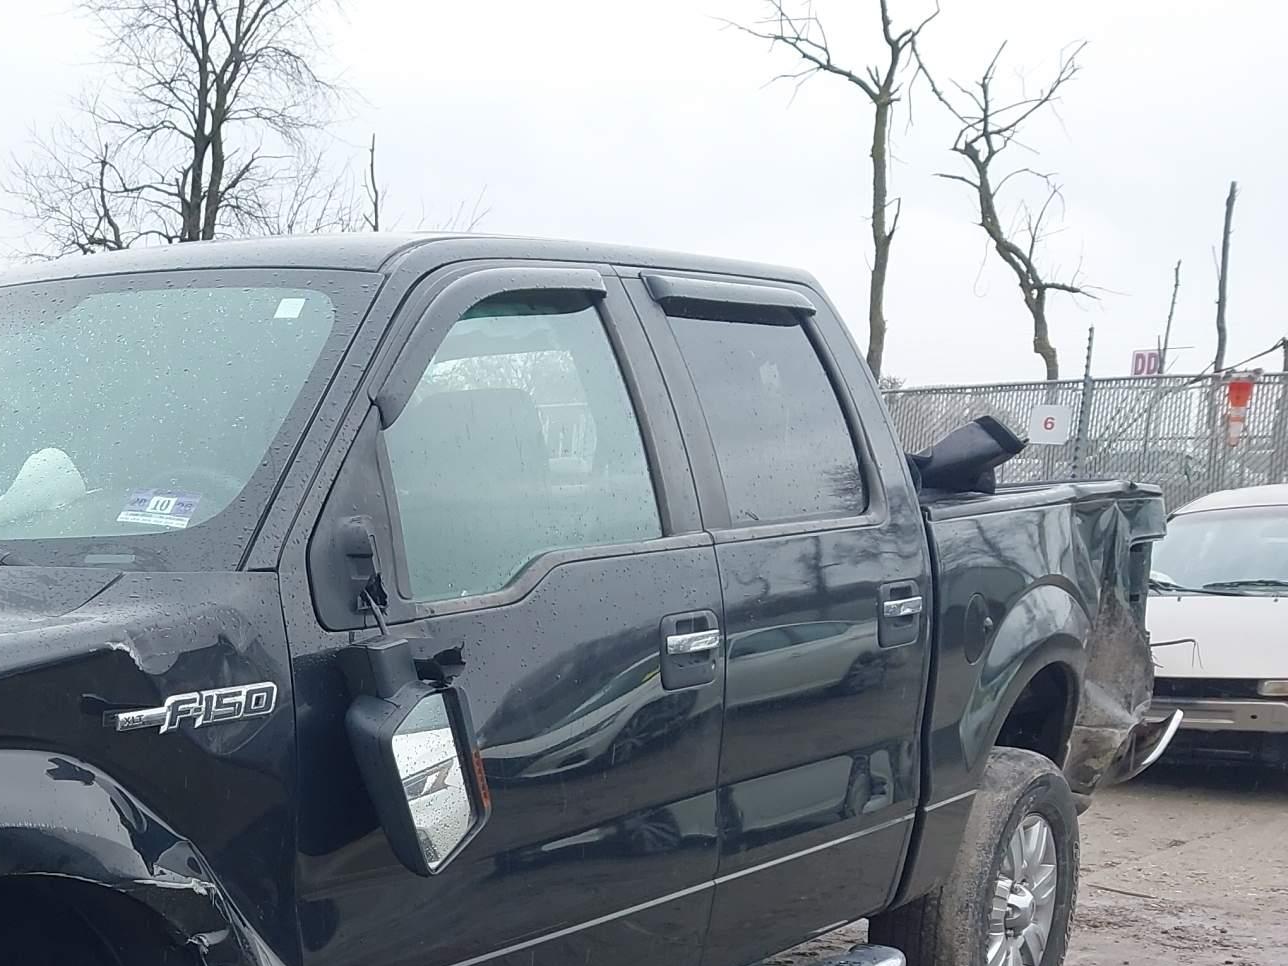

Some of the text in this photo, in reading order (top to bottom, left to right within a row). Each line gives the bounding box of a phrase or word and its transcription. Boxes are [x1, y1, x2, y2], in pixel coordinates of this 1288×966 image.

[1043, 416, 1056, 431] 6
[150, 499, 171, 512] 10
[122, 681, 278, 735] XLT F-150
